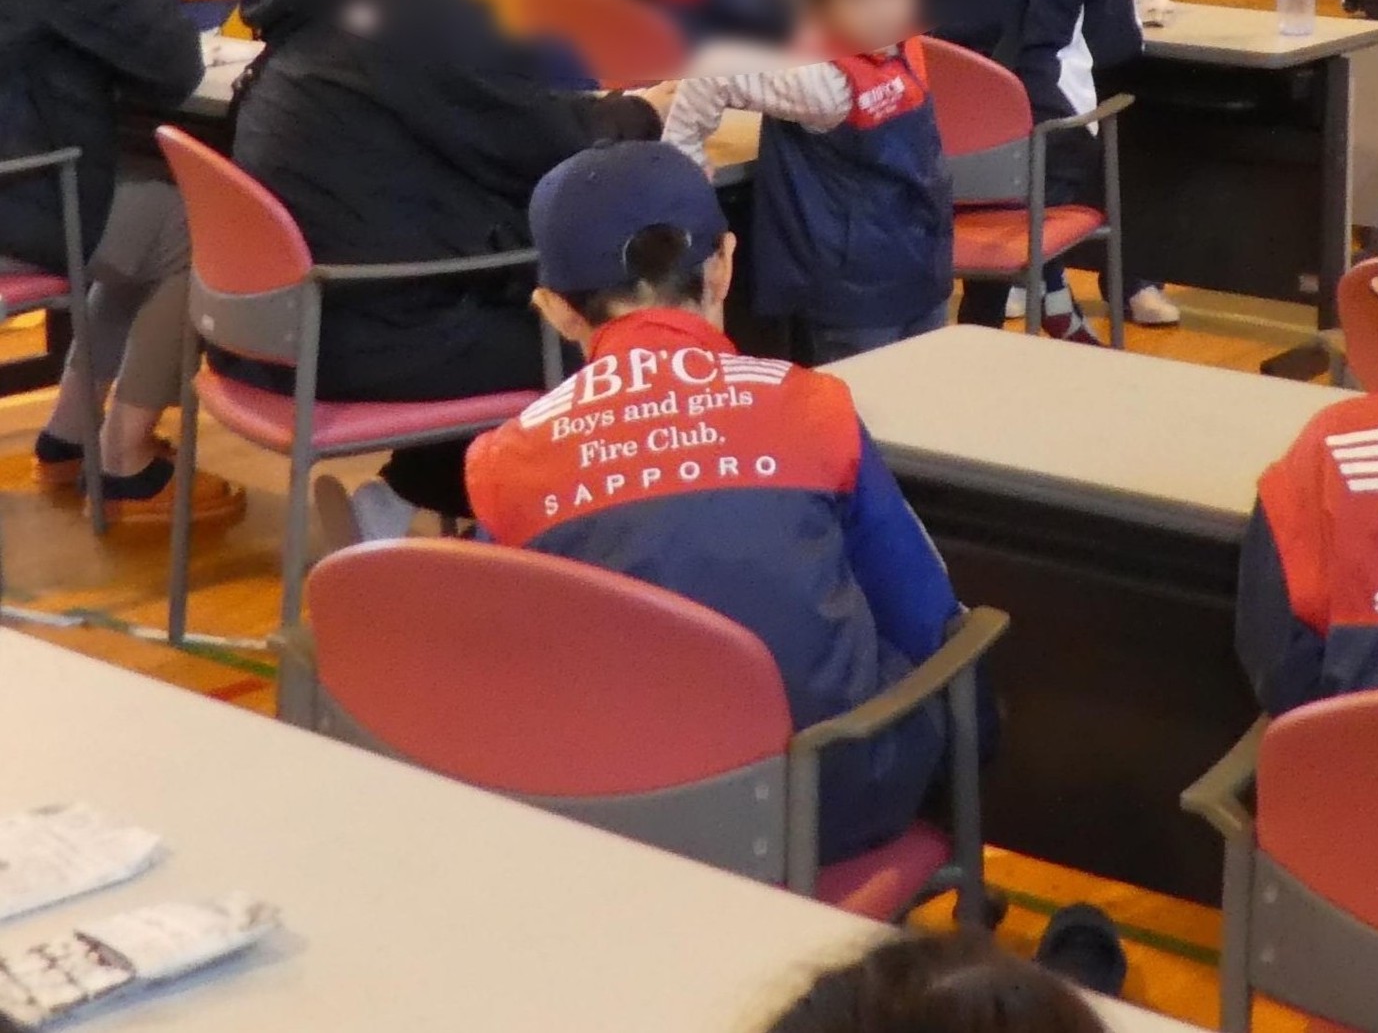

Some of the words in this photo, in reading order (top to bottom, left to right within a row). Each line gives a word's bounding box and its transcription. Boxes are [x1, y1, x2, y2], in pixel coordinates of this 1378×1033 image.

[577, 347, 718, 404] BFC
[551, 409, 615, 442] Boys
[624, 392, 679, 421] and
[688, 385, 753, 416] girls
[579, 438, 638, 469] Fire
[647, 422, 726, 452] Club.
[543, 455, 777, 516] SAPPORO
